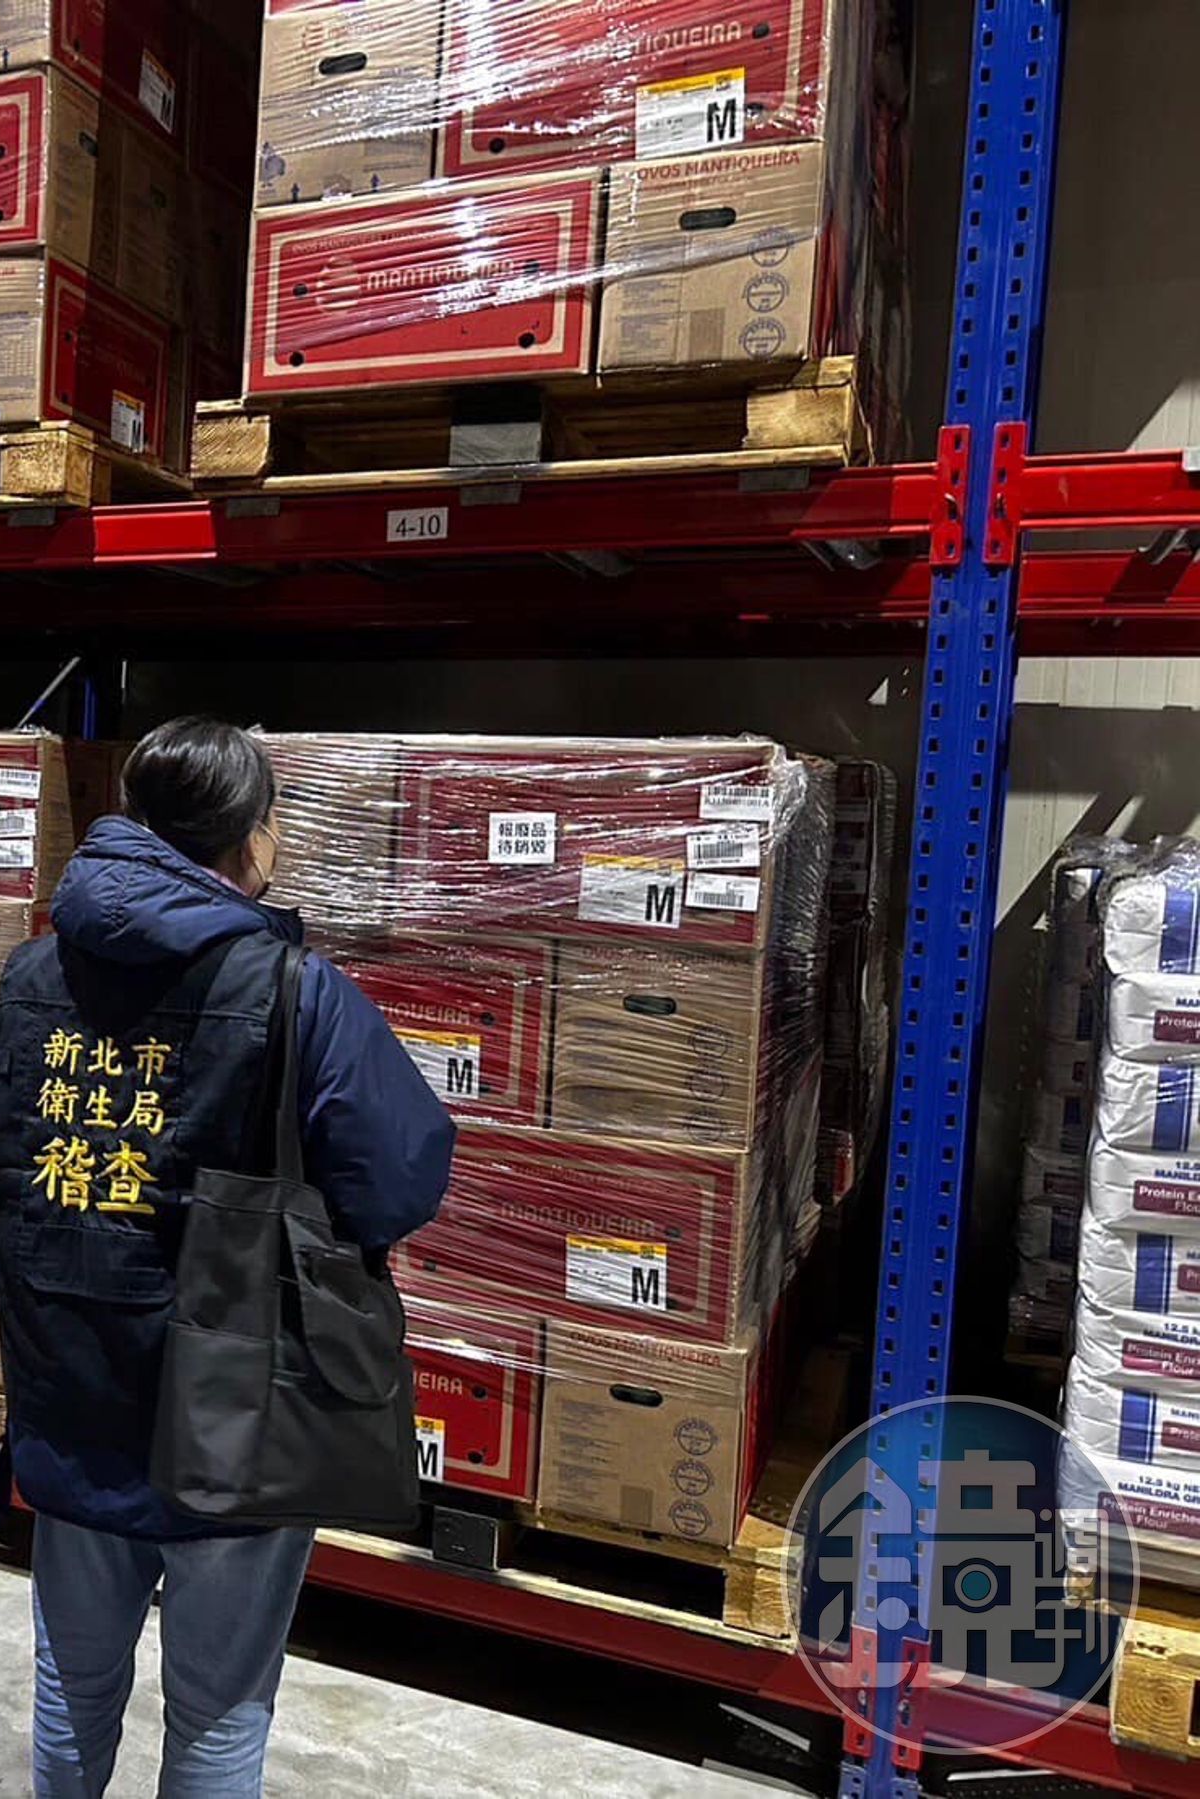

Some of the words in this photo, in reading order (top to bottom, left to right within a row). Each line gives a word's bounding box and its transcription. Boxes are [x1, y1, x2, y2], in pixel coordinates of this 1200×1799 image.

[707, 98, 737, 143] M
[637, 164, 681, 181] OVOS
[685, 151, 801, 172] MANTIQUEIRA
[395, 514, 440, 537] 4-10
[644, 884, 675, 925] M
[43, 1028, 172, 1085] 新北市
[447, 1057, 473, 1094] M
[36, 1077, 166, 1135] 衛生局
[32, 1136, 158, 1215] 稽查
[1139, 1186, 1185, 1200] Protein
[632, 1267, 659, 1305] M
[1162, 1361, 1194, 1376] Flour
[416, 1440, 438, 1477] M
[1118, 1481, 1179, 1500] MANILDRA
[1139, 1476, 1163, 1487] 12.5
[1137, 1515, 1167, 1529] Flour
